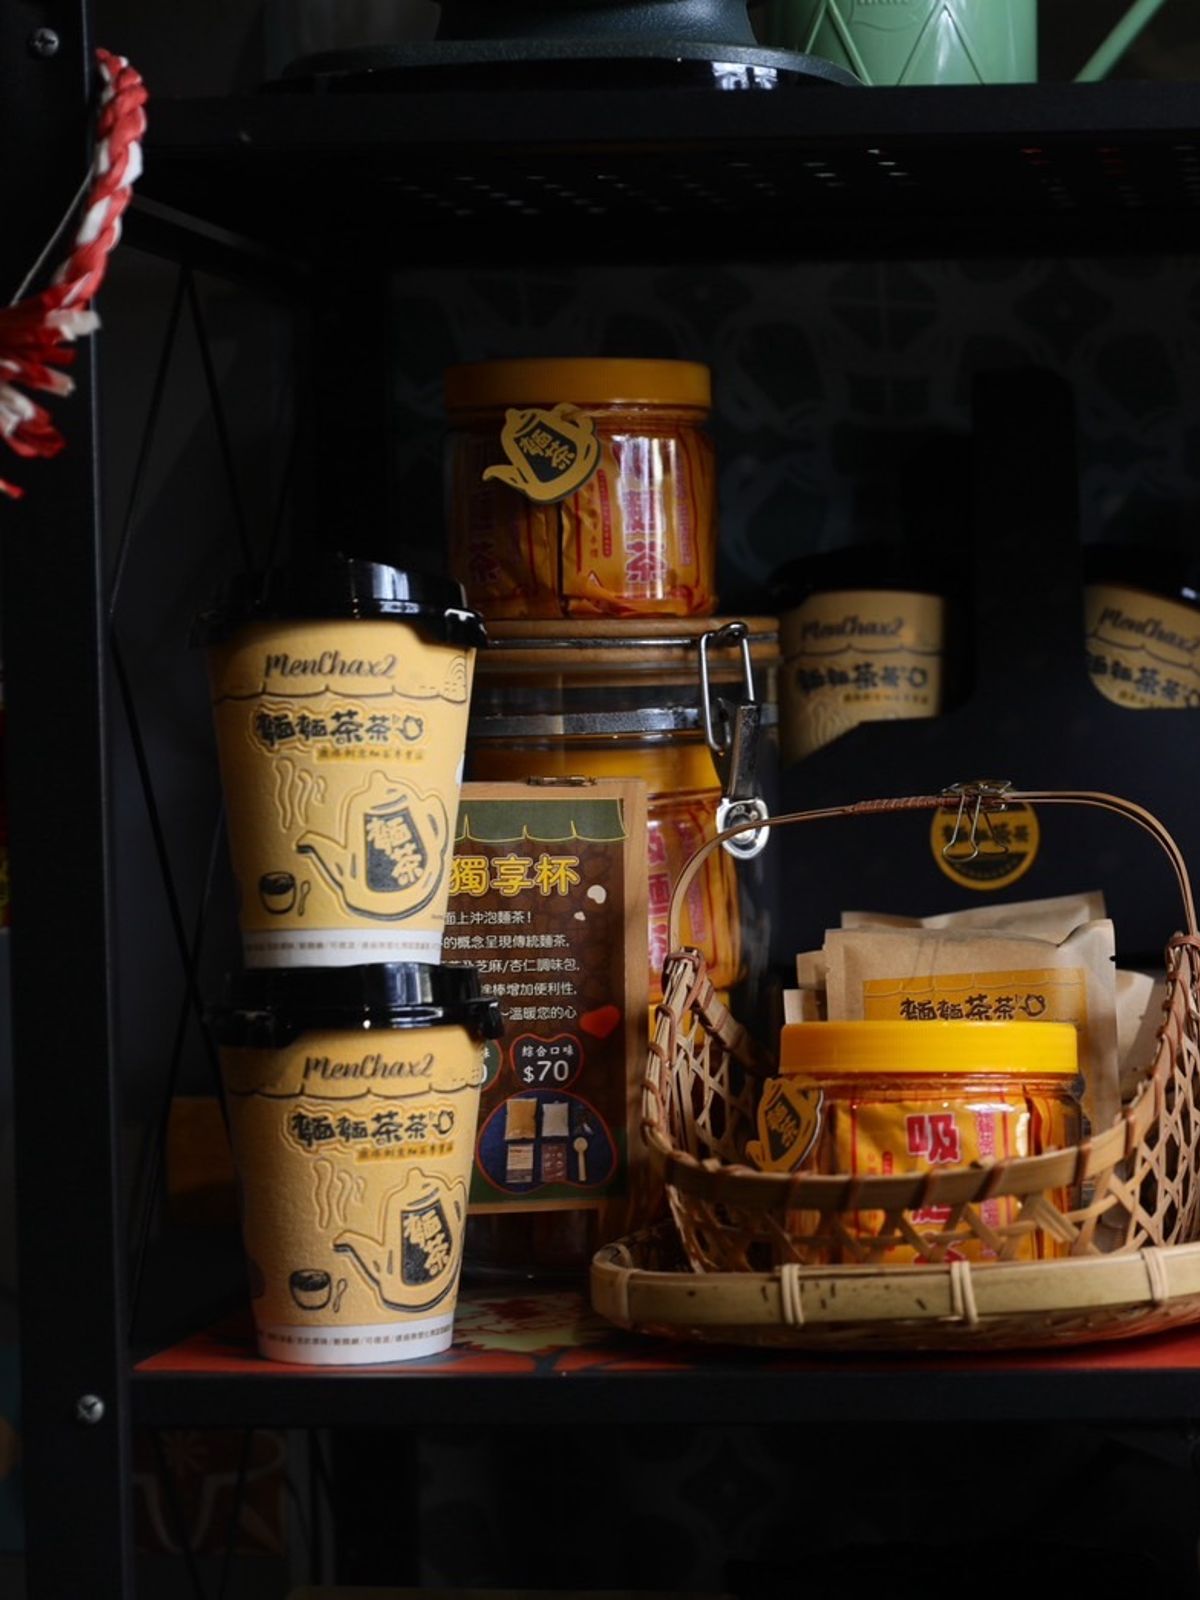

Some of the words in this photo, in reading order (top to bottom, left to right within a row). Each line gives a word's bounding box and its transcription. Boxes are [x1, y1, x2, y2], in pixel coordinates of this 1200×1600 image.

[264, 651, 398, 680] MenChax2
[450, 854, 580, 896] 獨享杯
[522, 1044, 574, 1057] 綜合口味
[302, 1053, 435, 1082] MenChax2
[523, 1060, 569, 1083] $70
